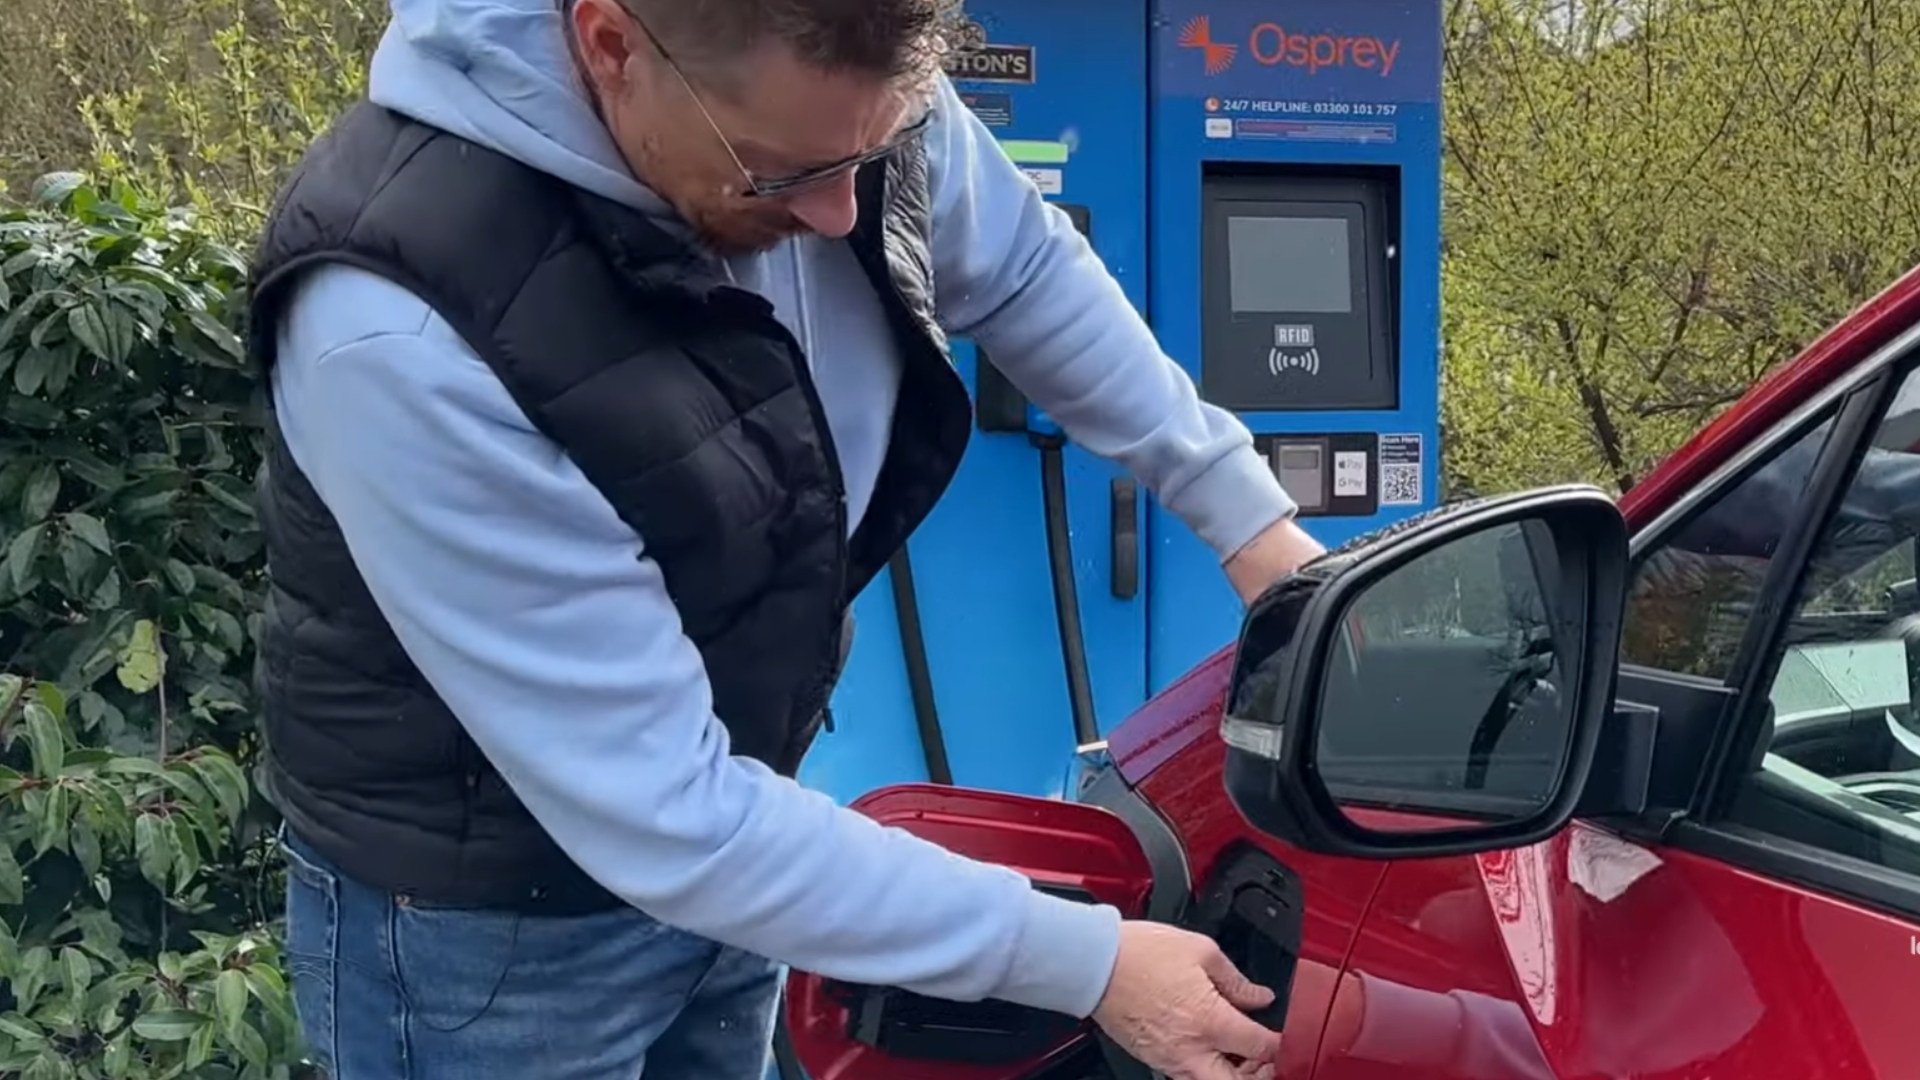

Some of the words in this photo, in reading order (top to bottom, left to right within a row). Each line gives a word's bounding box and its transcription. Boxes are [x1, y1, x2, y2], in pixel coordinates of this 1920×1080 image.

[1249, 22, 1399, 77] Osprey
[1223, 100, 1249, 112] 24/7
[1251, 101, 1312, 113] HELPLINE:
[1313, 102, 1349, 114] 03300
[1353, 103, 1373, 115] 101
[1376, 104, 1397, 116] 757
[1278, 328, 1311, 344] RFID
[1347, 459, 1364, 471] Pay
[1348, 478, 1363, 489] Pay
